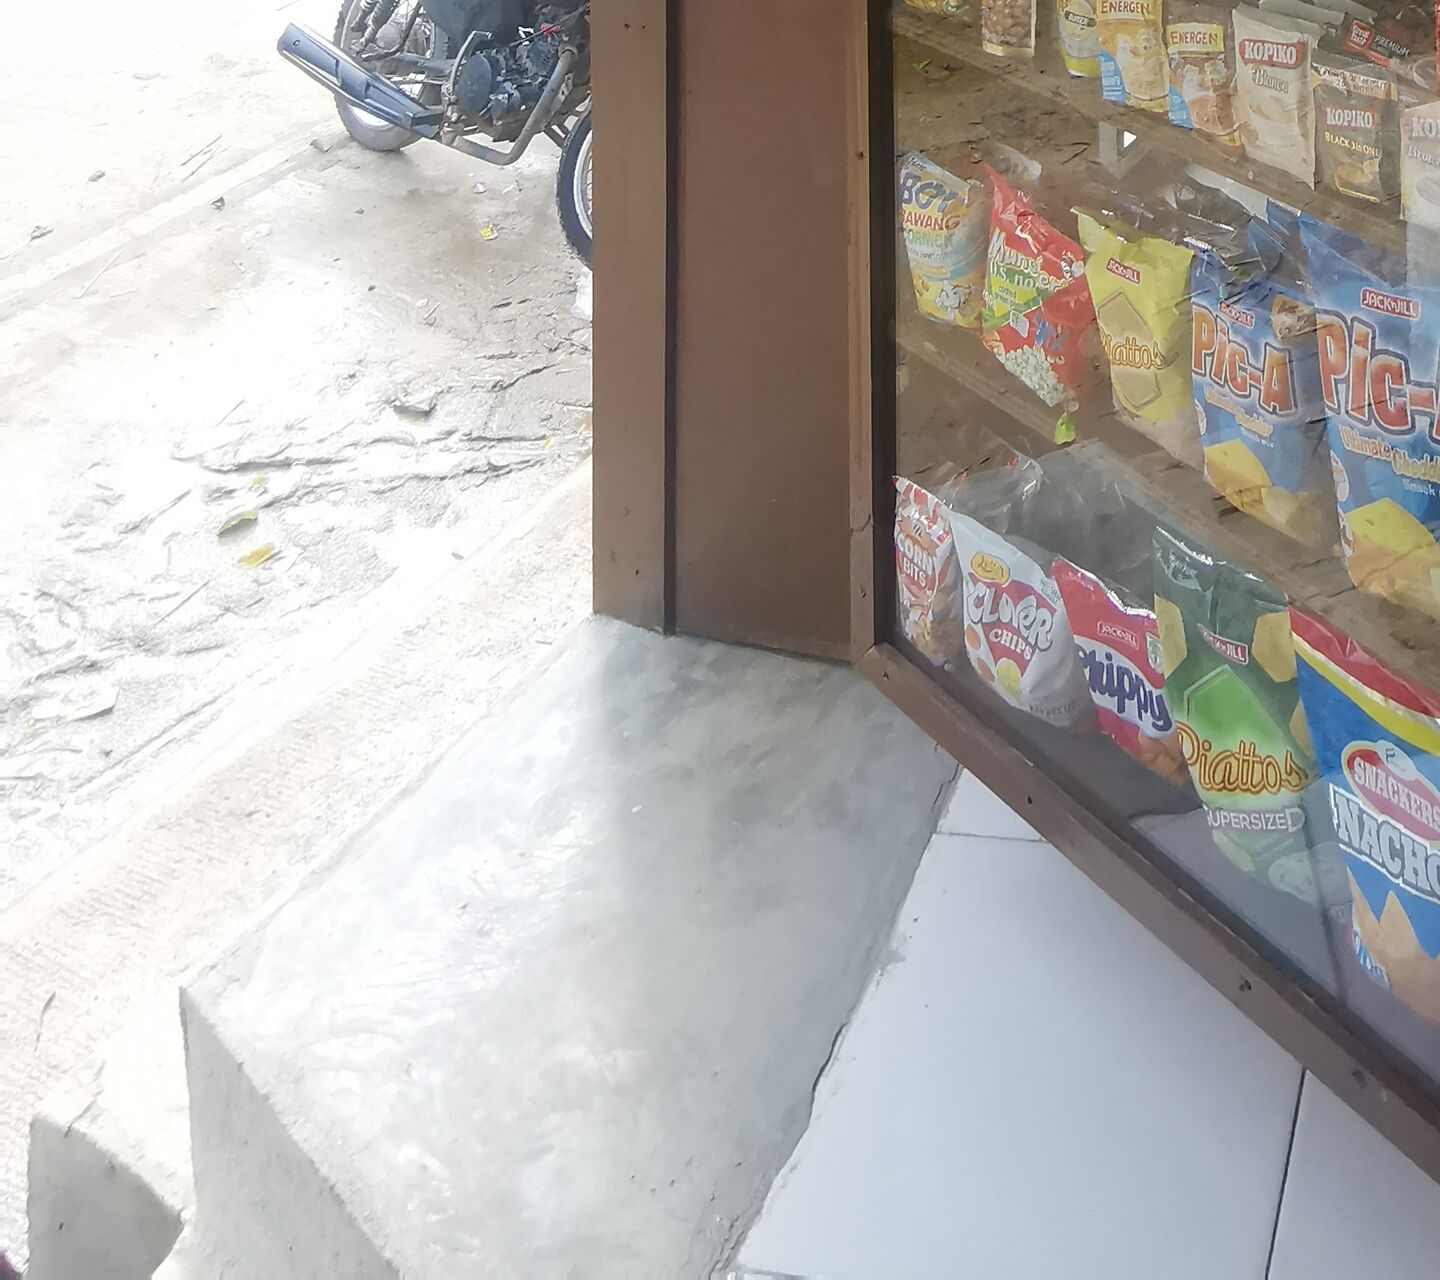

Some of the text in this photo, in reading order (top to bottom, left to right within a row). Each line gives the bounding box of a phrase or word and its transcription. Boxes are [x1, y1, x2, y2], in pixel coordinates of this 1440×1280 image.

[1101, 0, 1150, 15] ENERGEN
[1171, 31, 1218, 45] ENERGEN
[1374, 34, 1411, 57] PREMIUM
[1244, 40, 1297, 65] KOPIKO
[1326, 108, 1373, 128] KOPIKO
[1324, 132, 1350, 148] BLACK
[989, 627, 1033, 660] CHIPS
